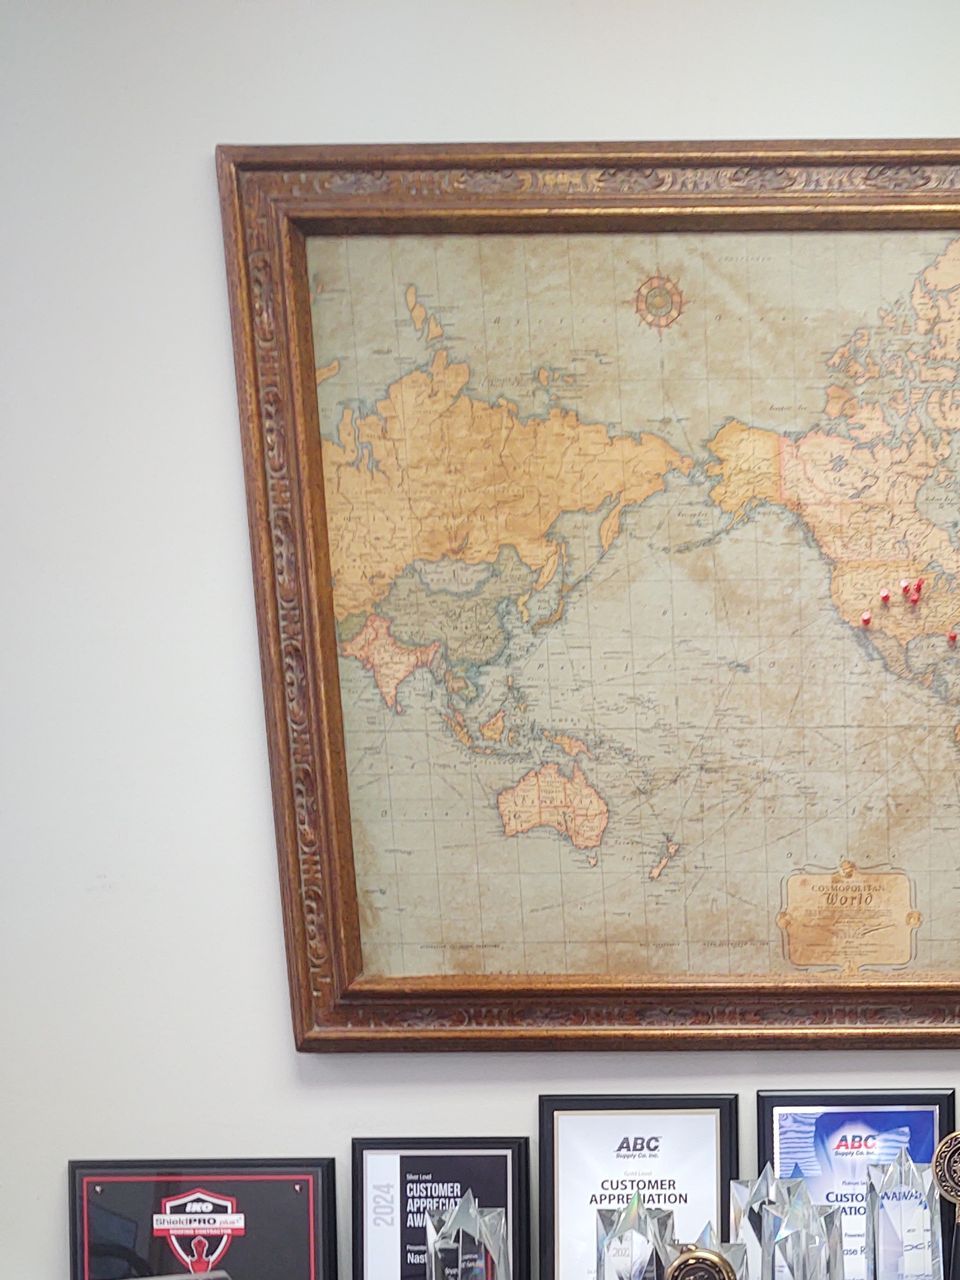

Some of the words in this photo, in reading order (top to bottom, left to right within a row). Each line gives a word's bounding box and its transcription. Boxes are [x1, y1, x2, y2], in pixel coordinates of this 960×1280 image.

[823, 892, 873, 906] World
[613, 1136, 662, 1152] ABC
[833, 1134, 879, 1150] ABC
[616, 1152, 639, 1160] Supply
[406, 1183, 461, 1197] CUSTOMER
[601, 1179, 676, 1191] CUSTOMER
[589, 1193, 688, 1205] APPREIATION
[826, 1191, 866, 1203] CUSTO
[185, 1202, 214, 1213] IKO
[372, 1183, 396, 1227] 2024
[406, 1197, 478, 1213] APPRECIAT
[407, 1253, 428, 1265] Nast
